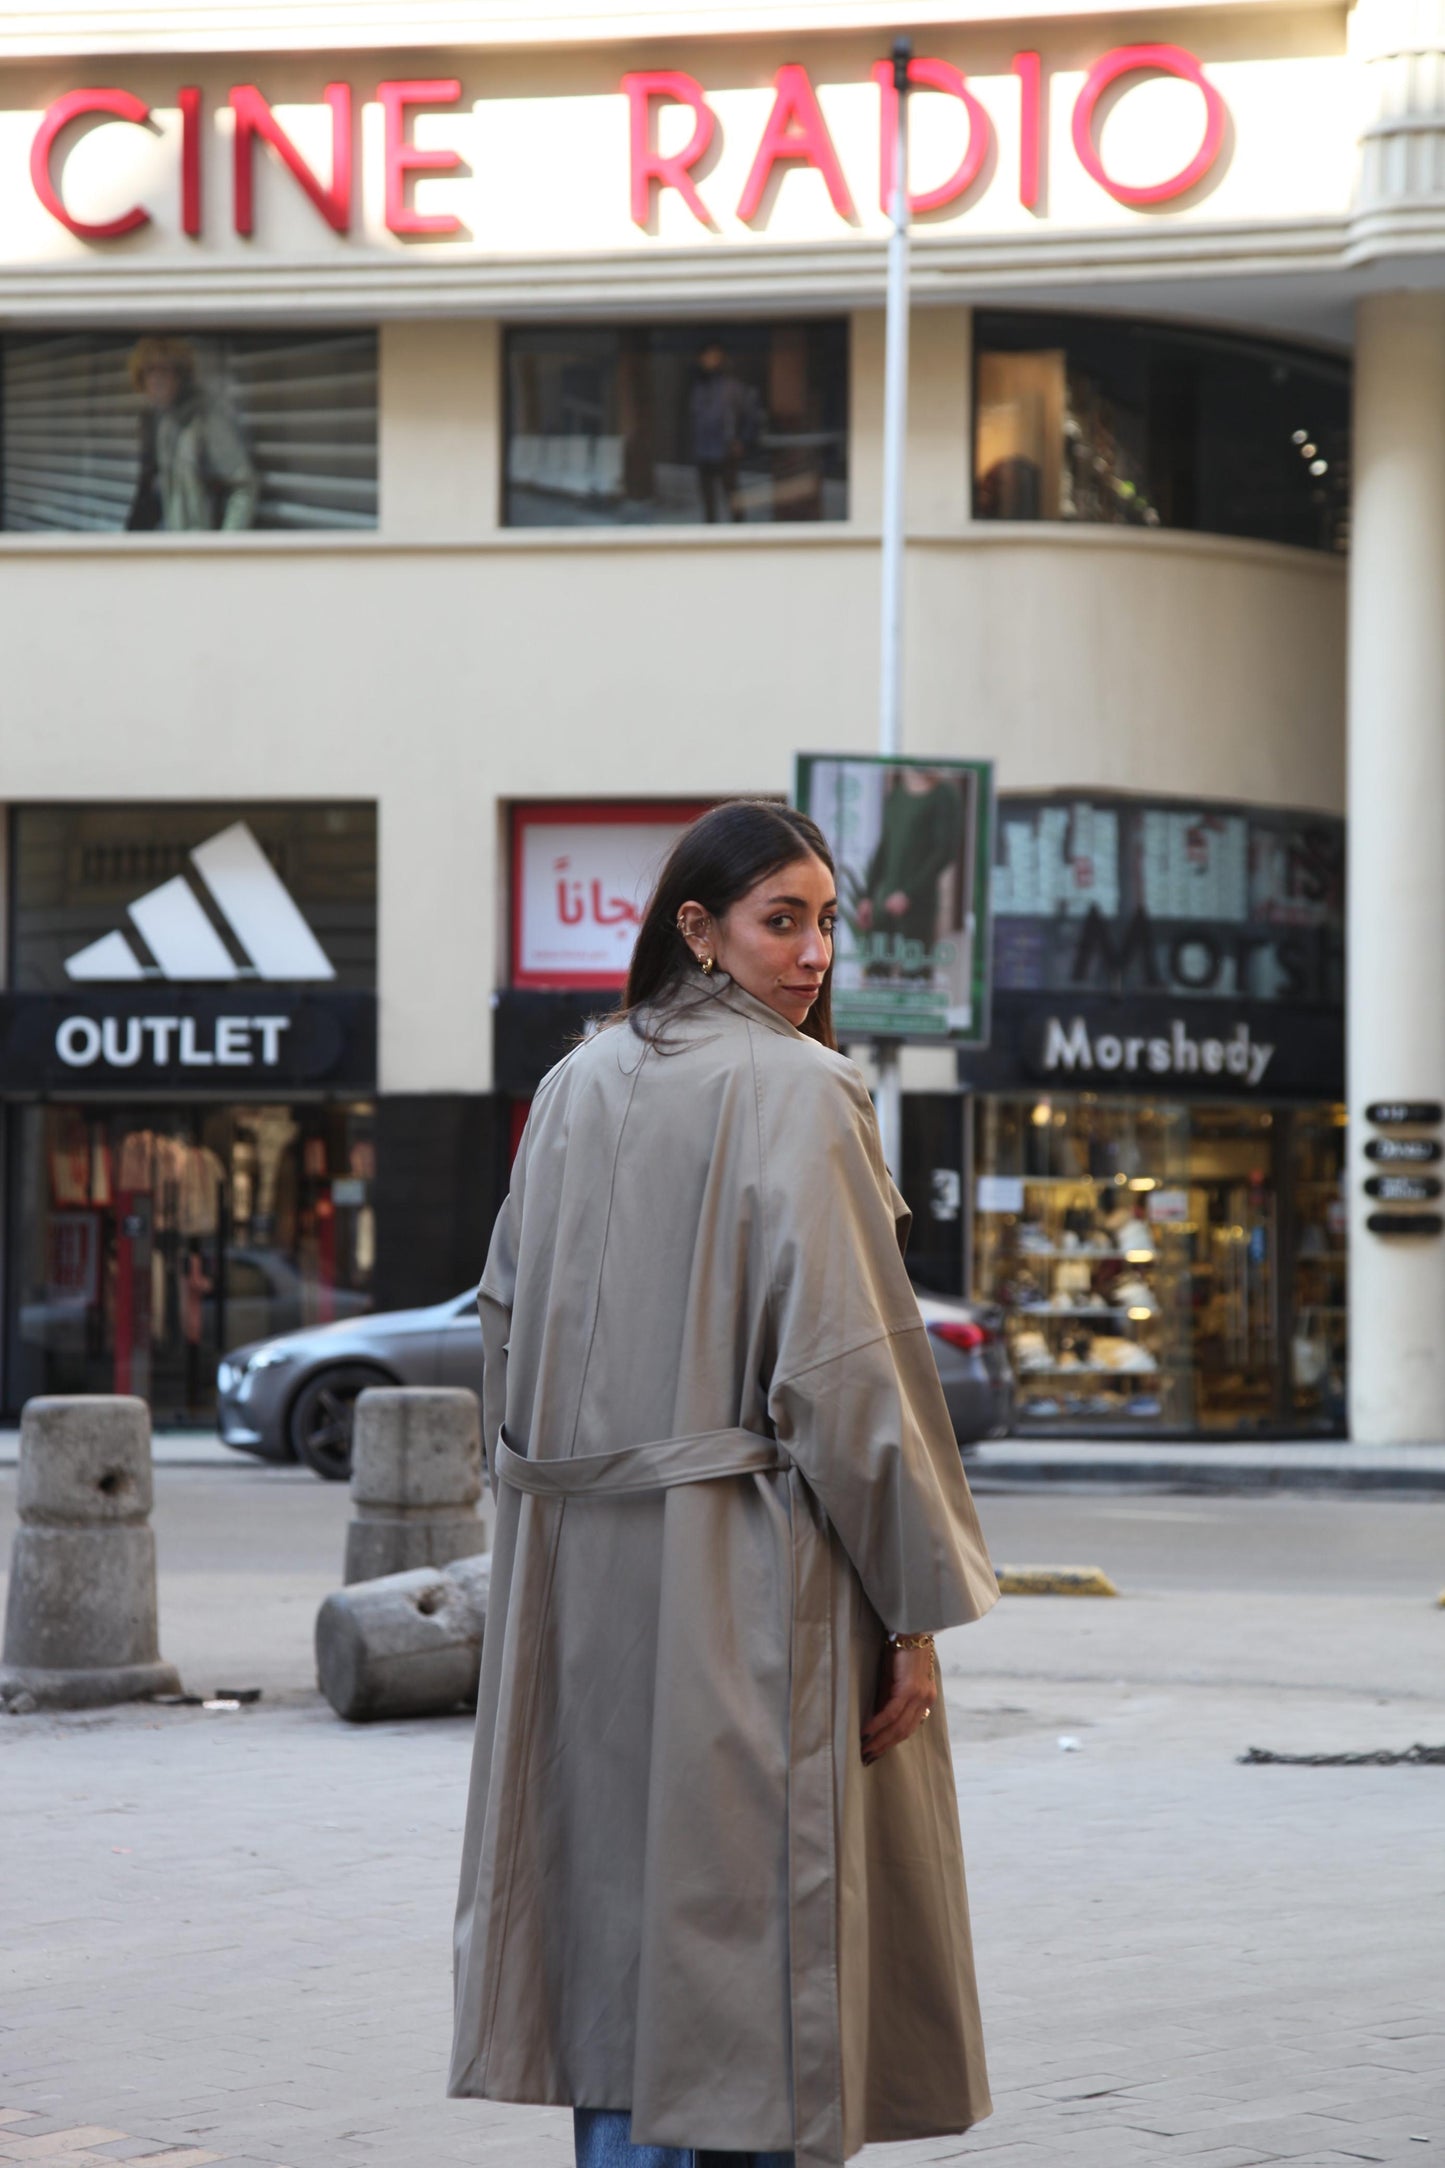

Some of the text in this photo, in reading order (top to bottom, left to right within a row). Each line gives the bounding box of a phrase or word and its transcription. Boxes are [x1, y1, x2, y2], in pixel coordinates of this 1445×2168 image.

[30, 43, 1228, 239] CINE RADIO
[55, 1016, 290, 1067] OUTLET
[1044, 1016, 1275, 1085] Morshedy
